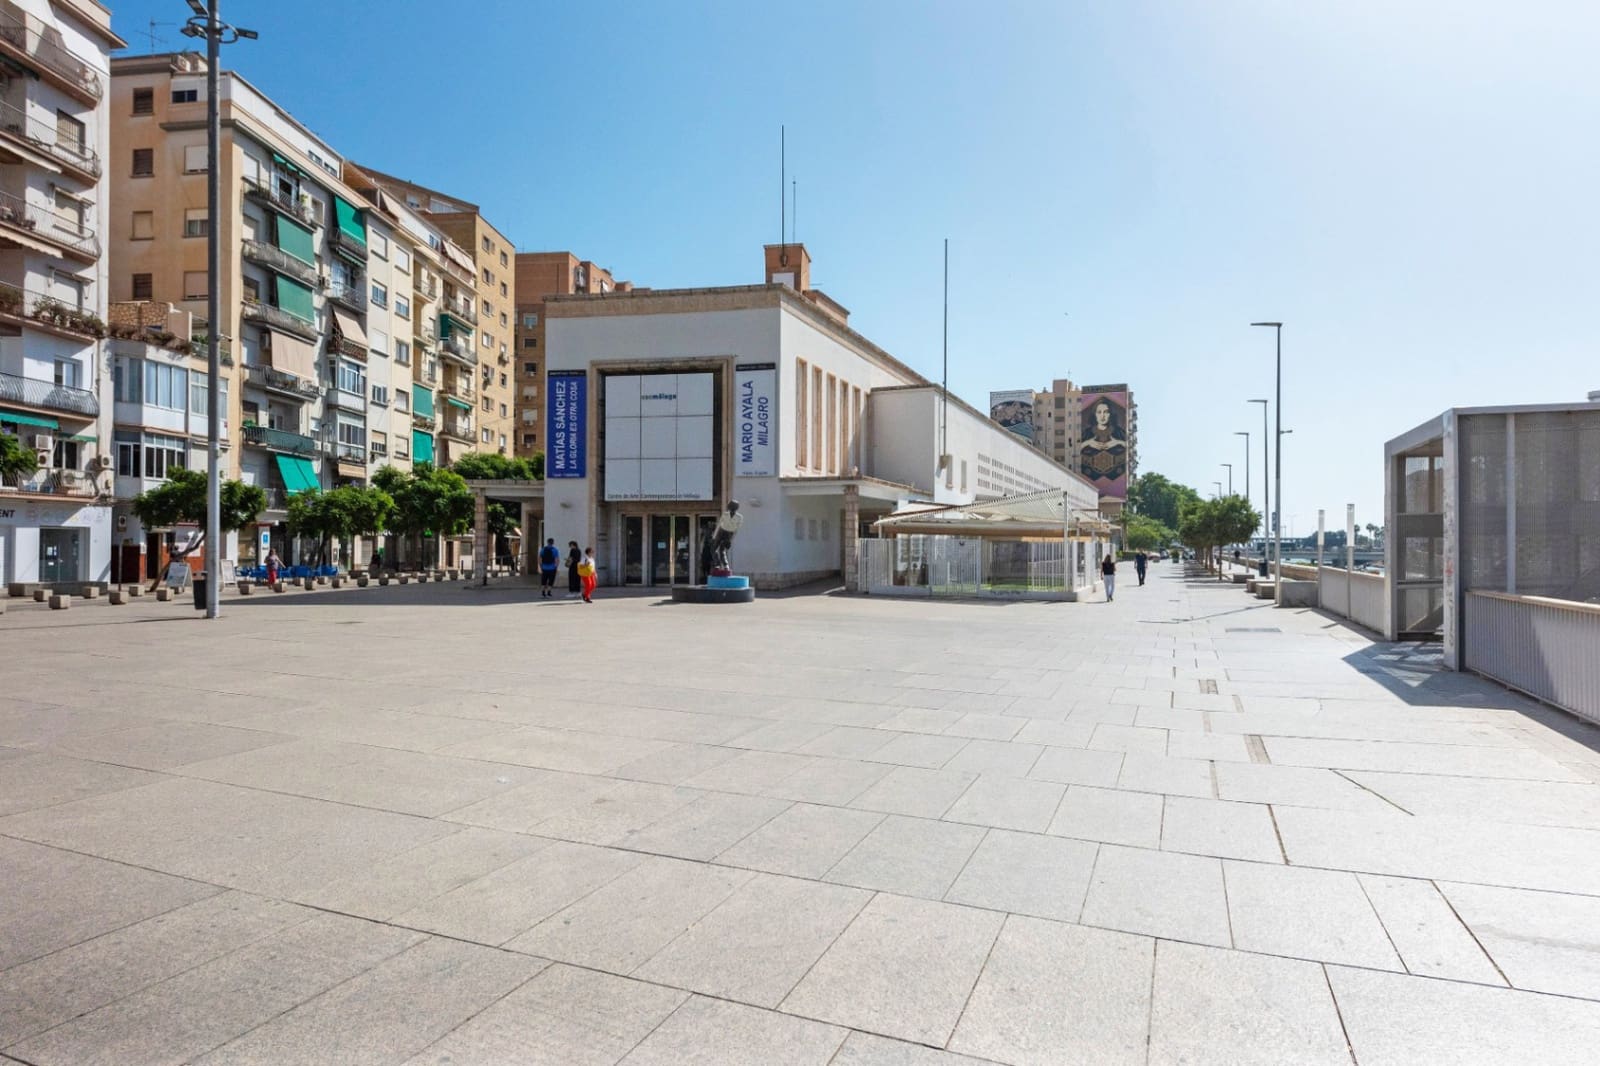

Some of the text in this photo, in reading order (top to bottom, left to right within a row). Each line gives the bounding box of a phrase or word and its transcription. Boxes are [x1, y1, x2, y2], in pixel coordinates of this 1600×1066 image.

[554, 381, 566, 429] SÁNCHEZ
[742, 381, 752, 462] MARIO AYALA
[758, 397, 768, 446] MILAGRO
[570, 422, 577, 432] ES
[554, 432, 566, 469] MATÍAS
[570, 460, 577, 469] LA
